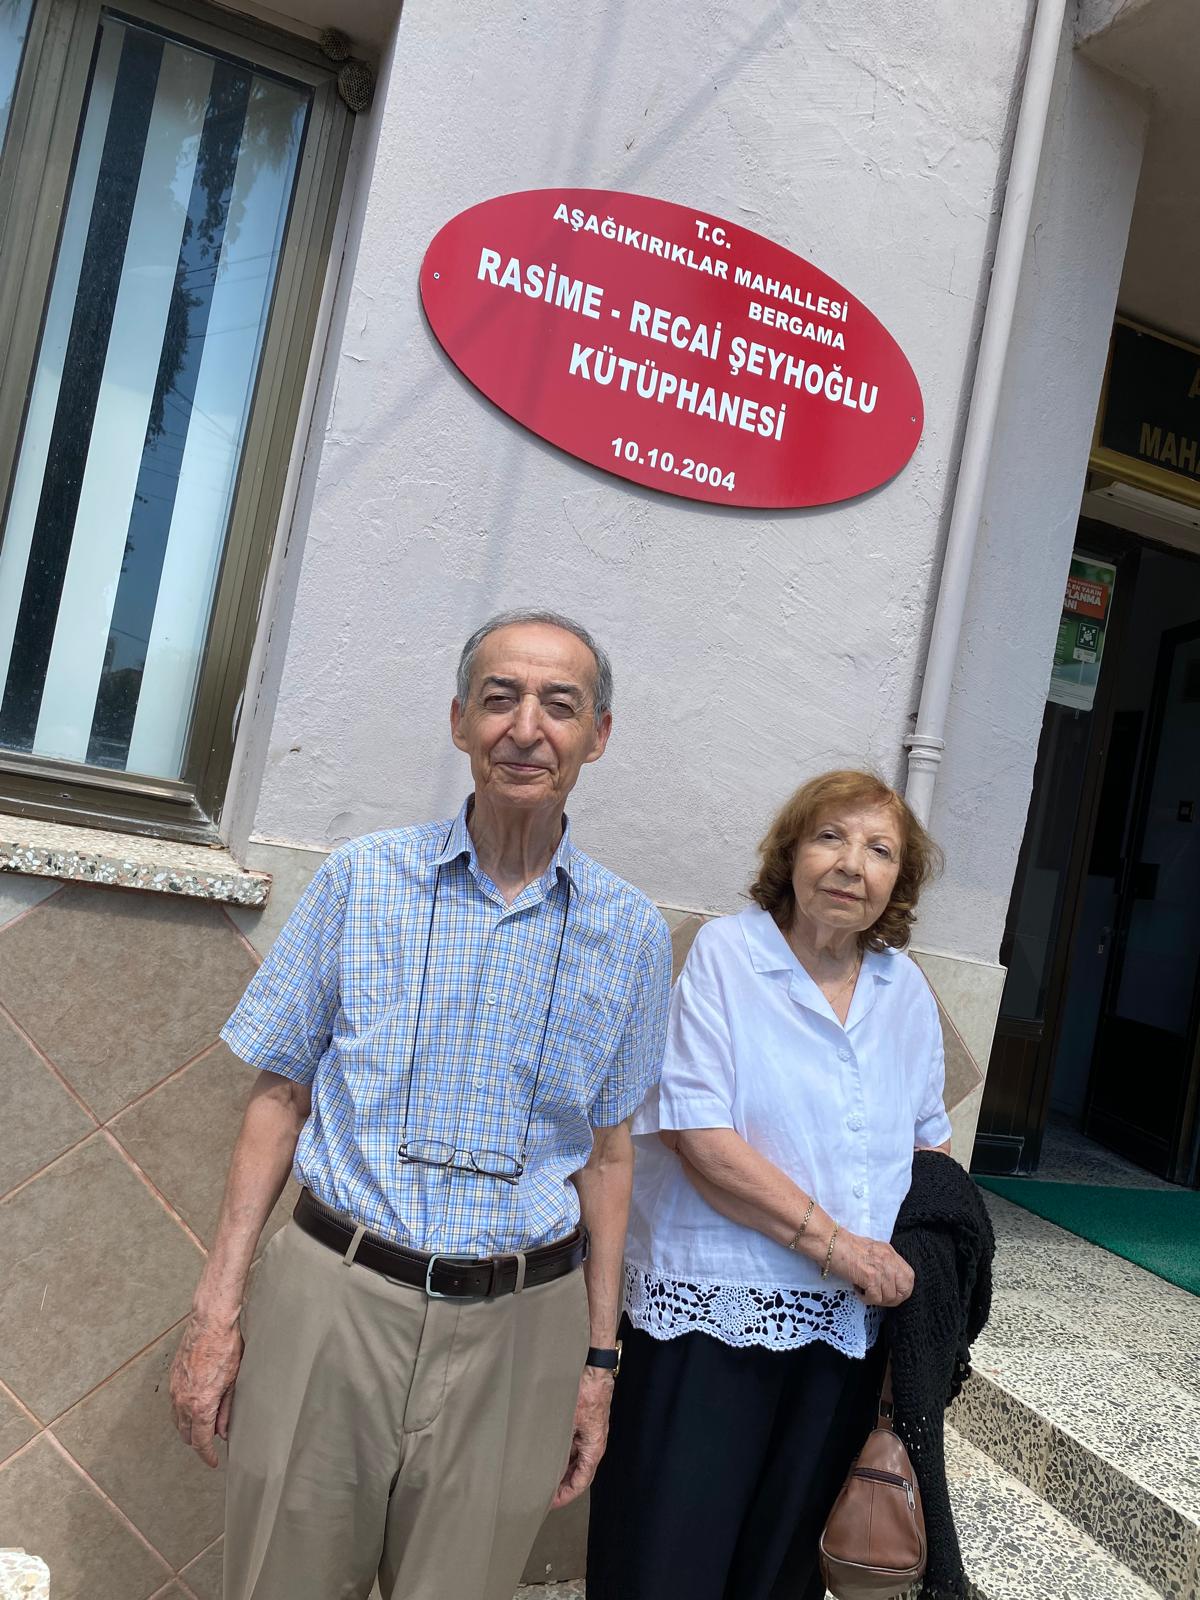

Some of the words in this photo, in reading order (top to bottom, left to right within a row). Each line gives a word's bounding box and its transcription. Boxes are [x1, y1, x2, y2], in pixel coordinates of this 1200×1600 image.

[695, 219, 731, 250] T.C.
[553, 203, 729, 280] AŞAĞIKIRIKLAR
[734, 266, 849, 323] MAHALLESİ
[477, 247, 604, 320] RASİME
[610, 308, 621, 319] -
[629, 300, 722, 361] RECAİ
[728, 336, 879, 414] ŞEYHOĞLU
[748, 301, 846, 351] BERGAMA
[568, 342, 787, 441] KÜTÜPHANESİ
[611, 437, 736, 492] 10.10.2004
[1140, 422, 1200, 474] MAH
